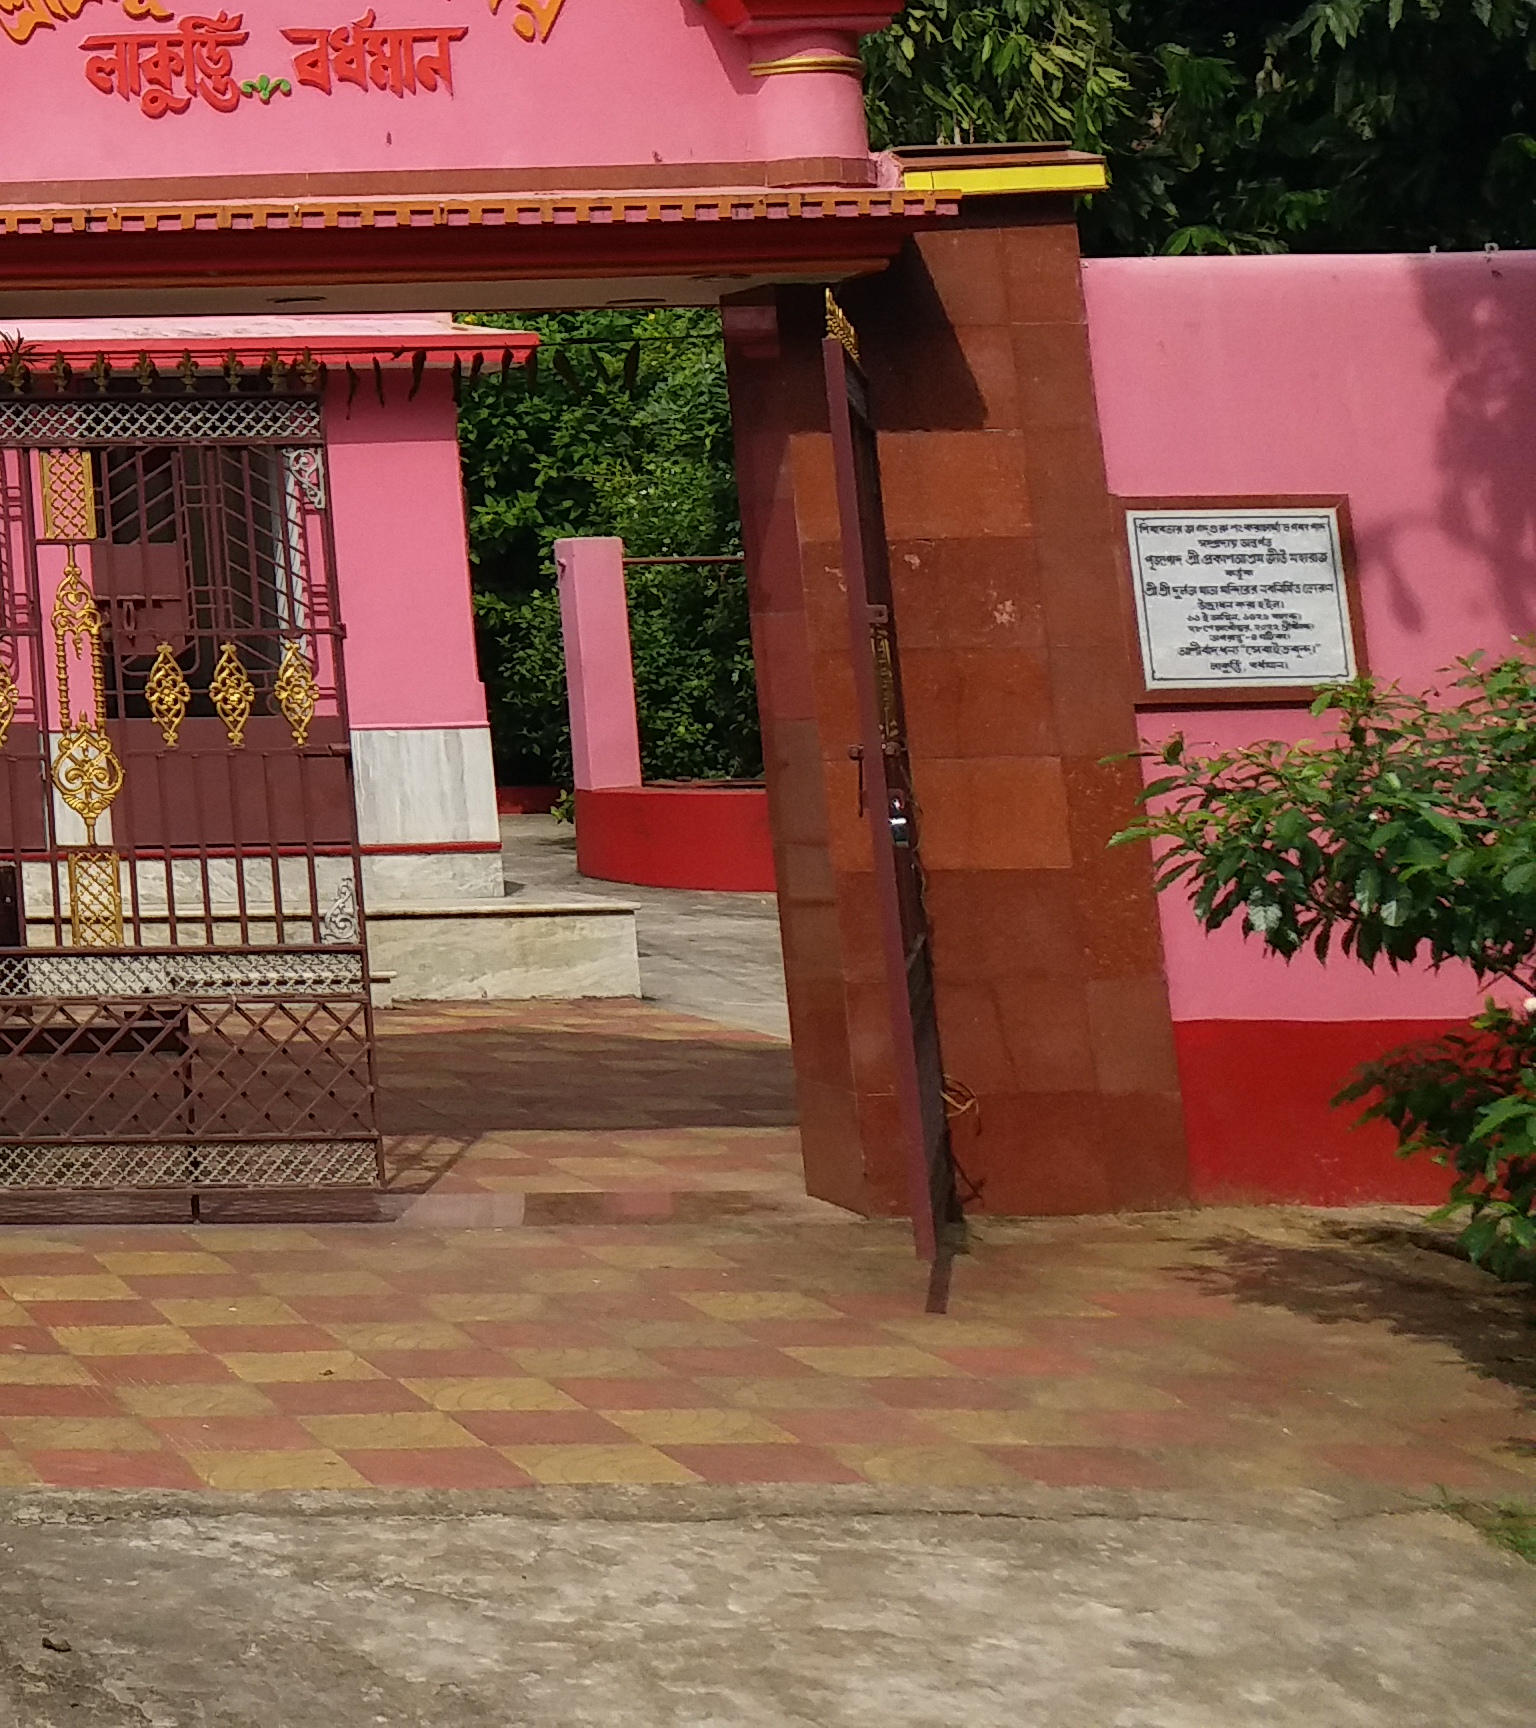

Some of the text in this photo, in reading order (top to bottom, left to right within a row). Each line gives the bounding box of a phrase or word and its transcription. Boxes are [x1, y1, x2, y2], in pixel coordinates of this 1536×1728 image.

[279, 8, 469, 101] বর্ধমান
[1186, 549, 1200, 565] শ্রী
[1145, 581, 1158, 596] শ্রী
[1158, 581, 1171, 596] শ্রী
